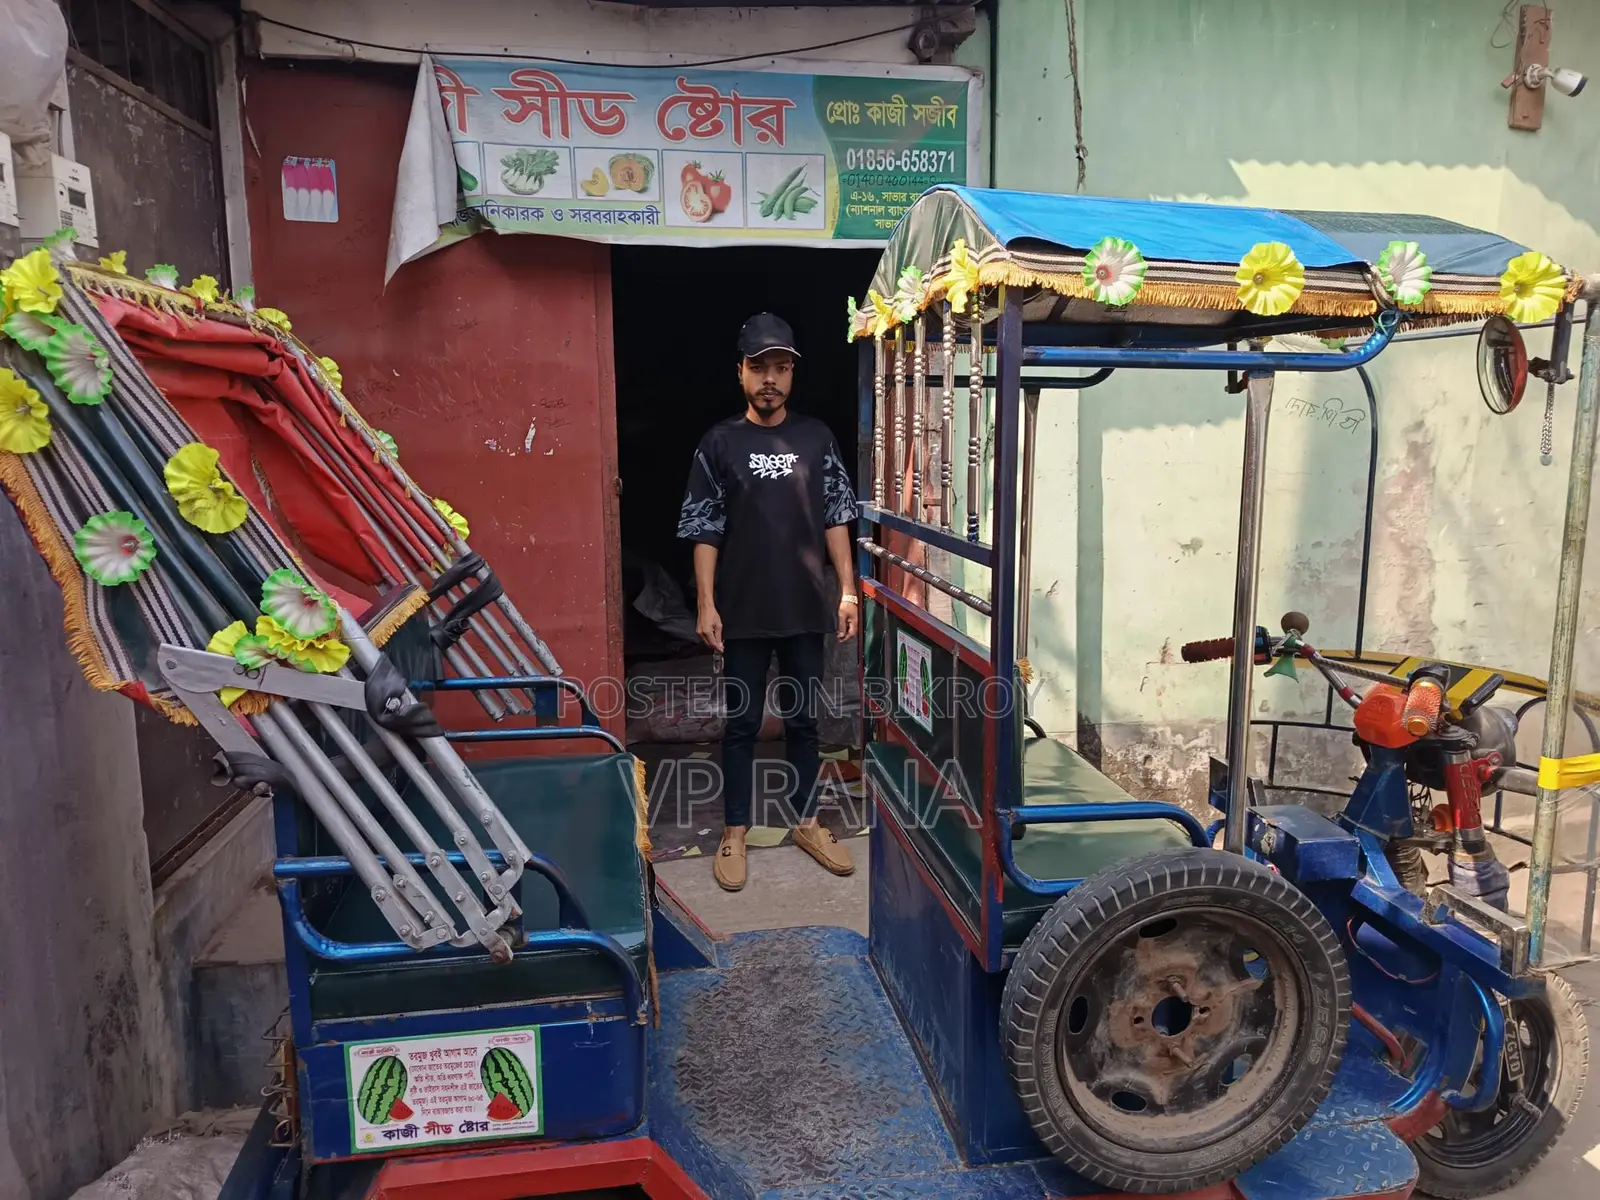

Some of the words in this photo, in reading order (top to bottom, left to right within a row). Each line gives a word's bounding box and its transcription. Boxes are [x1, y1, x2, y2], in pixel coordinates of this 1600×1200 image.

[491, 68, 637, 140] সীড
[656, 76, 796, 147] ষ্টোর
[827, 99, 860, 125] প্রোঃ
[865, 94, 908, 126] কাজী
[912, 96, 958, 128] সজীব
[846, 148, 955, 173] 01856-658371
[882, 191, 907, 202] সাভার
[551, 207, 564, 221] ও
[568, 204, 661, 226] সরবরাহকারী
[408, 1052, 427, 1062] তরমুজ
[443, 1048, 461, 1058] আগাম
[381, 1123, 420, 1140] কাজী
[423, 1121, 453, 1136] সীড
[459, 1119, 490, 1133] ষ্টোর
